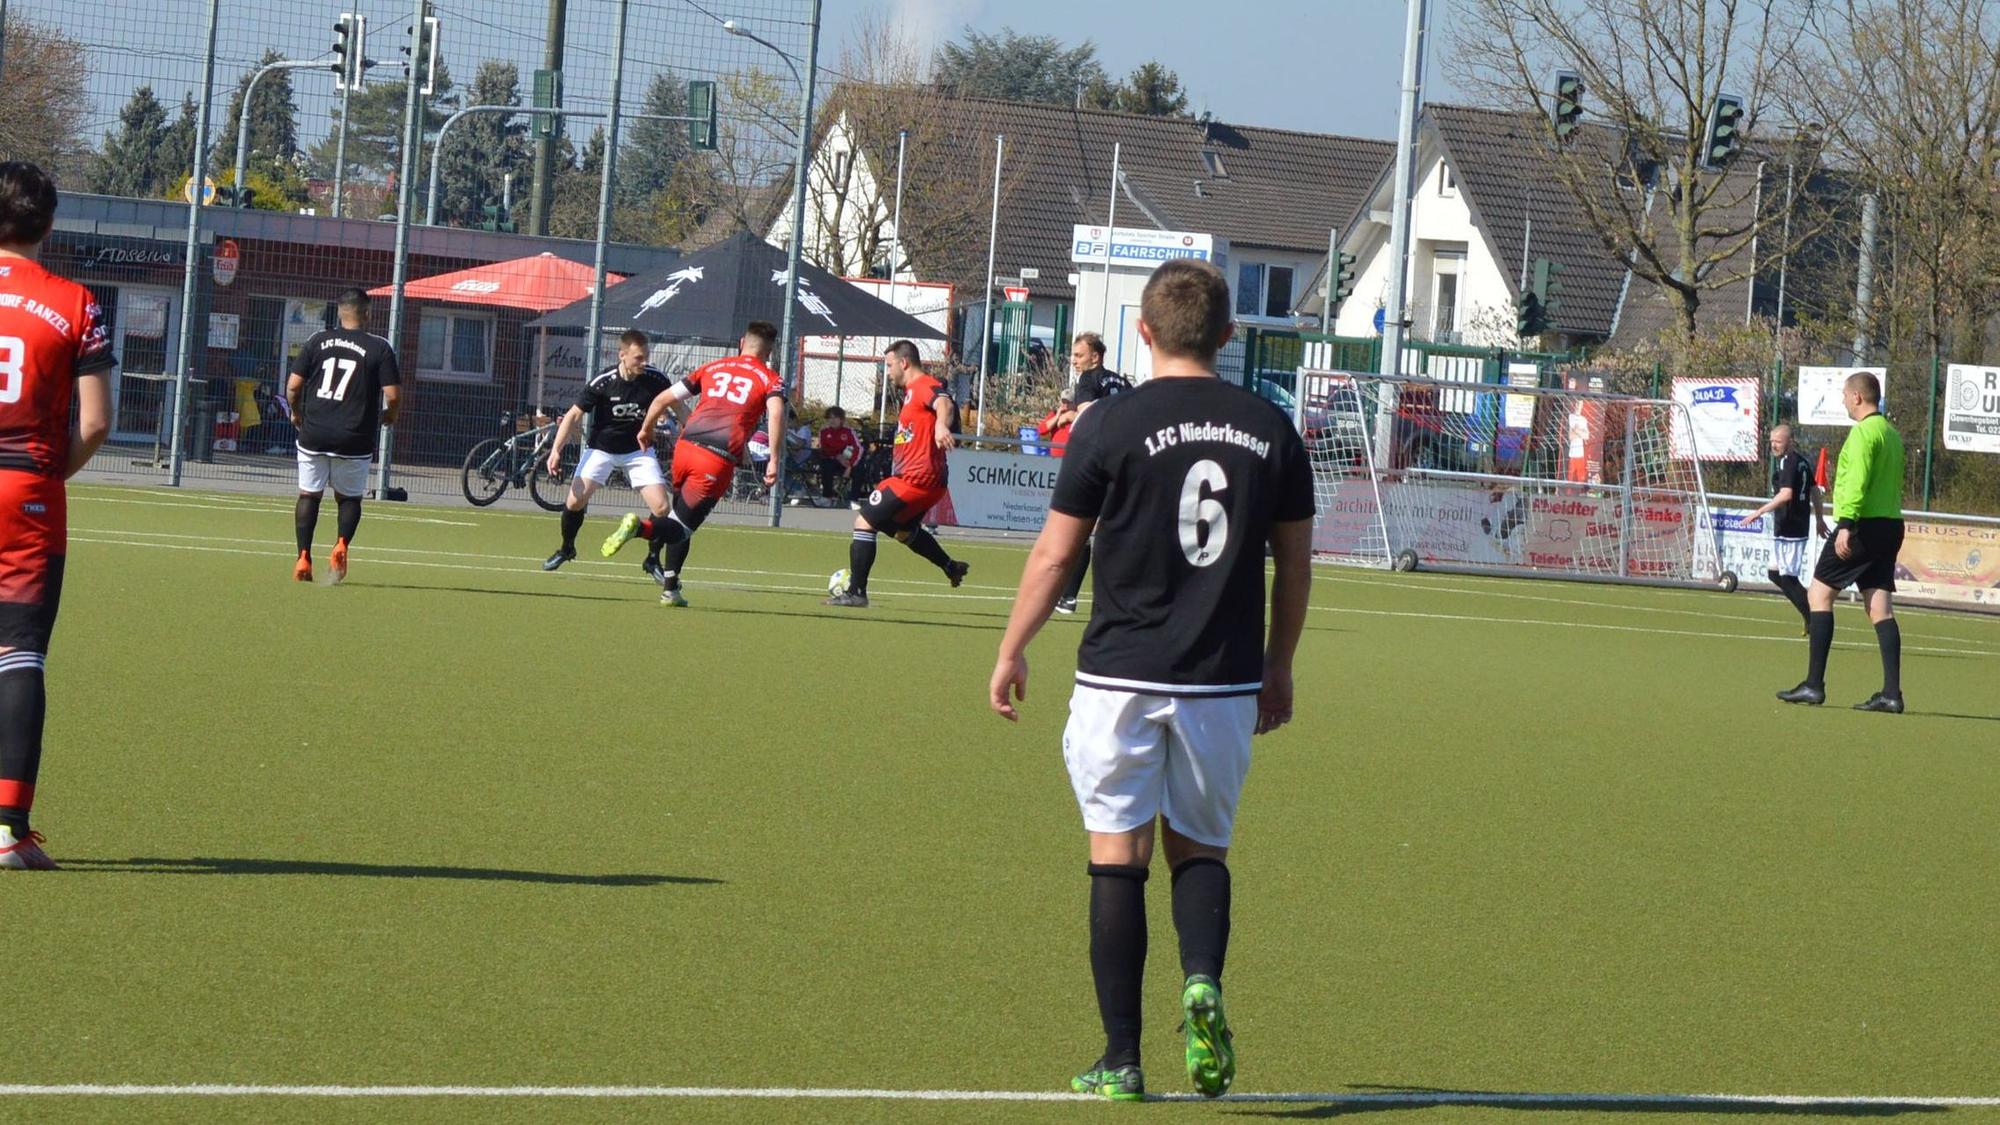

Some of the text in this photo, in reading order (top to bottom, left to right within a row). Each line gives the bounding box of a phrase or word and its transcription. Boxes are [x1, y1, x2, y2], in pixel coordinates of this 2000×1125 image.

[0, 293, 71, 337] ORF-RANZEL
[316, 356, 357, 402] 17
[707, 371, 753, 405] 33
[1144, 421, 1270, 459] 1.FC Niederkassel
[1177, 458, 1228, 567] 6
[1918, 585, 1936, 594] Jeep
